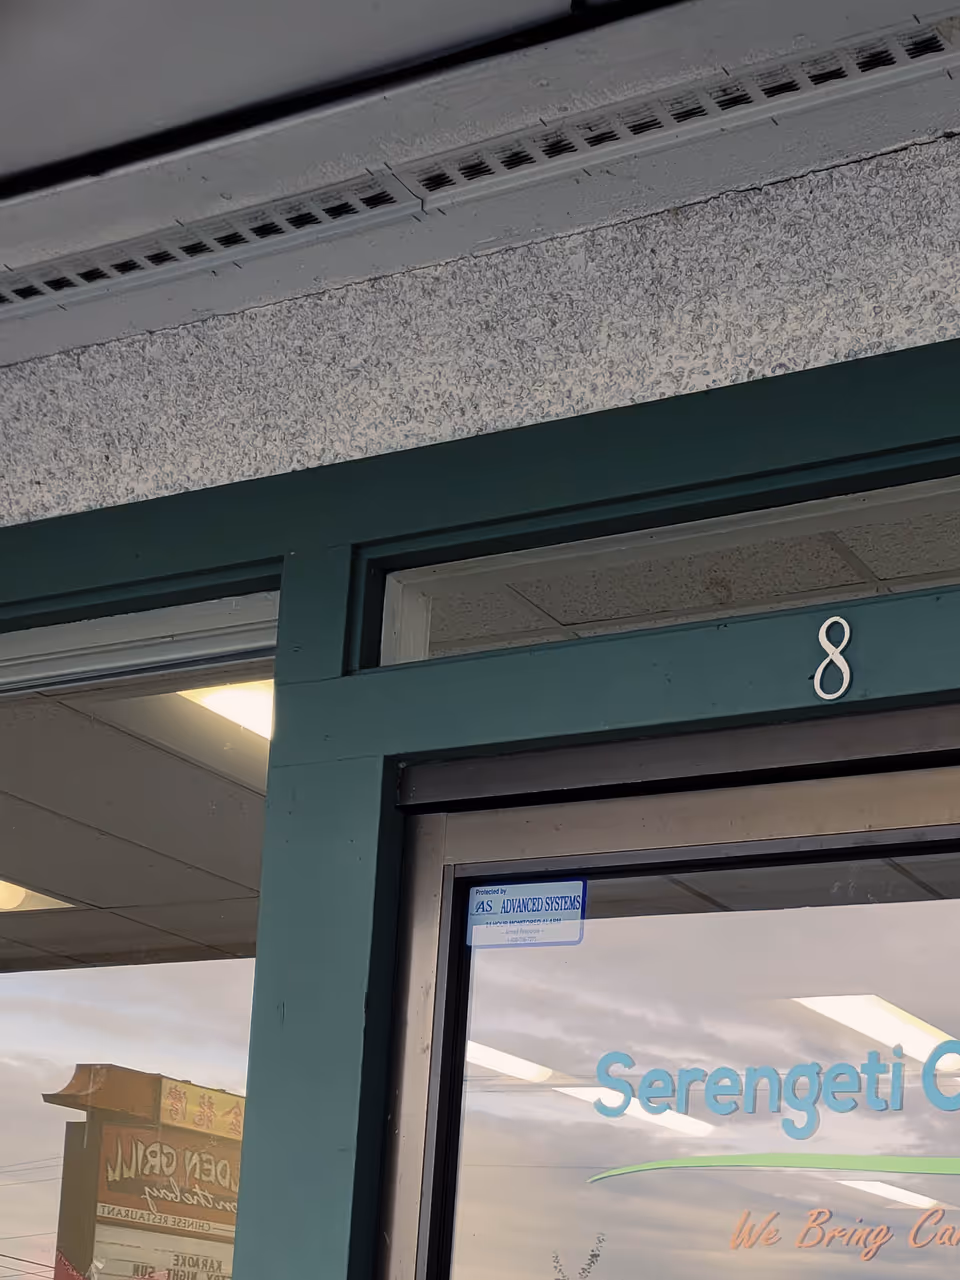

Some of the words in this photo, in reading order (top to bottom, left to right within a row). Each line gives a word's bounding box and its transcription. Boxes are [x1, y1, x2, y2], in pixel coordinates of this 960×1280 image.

[814, 616, 850, 700] 8
[475, 899, 493, 913] AS
[500, 896, 544, 914] ADVANCED
[544, 894, 581, 912] SYSTEMS
[592, 1043, 905, 1140] Serengeti
[730, 1209, 780, 1251] We
[795, 1208, 894, 1261] Bring
